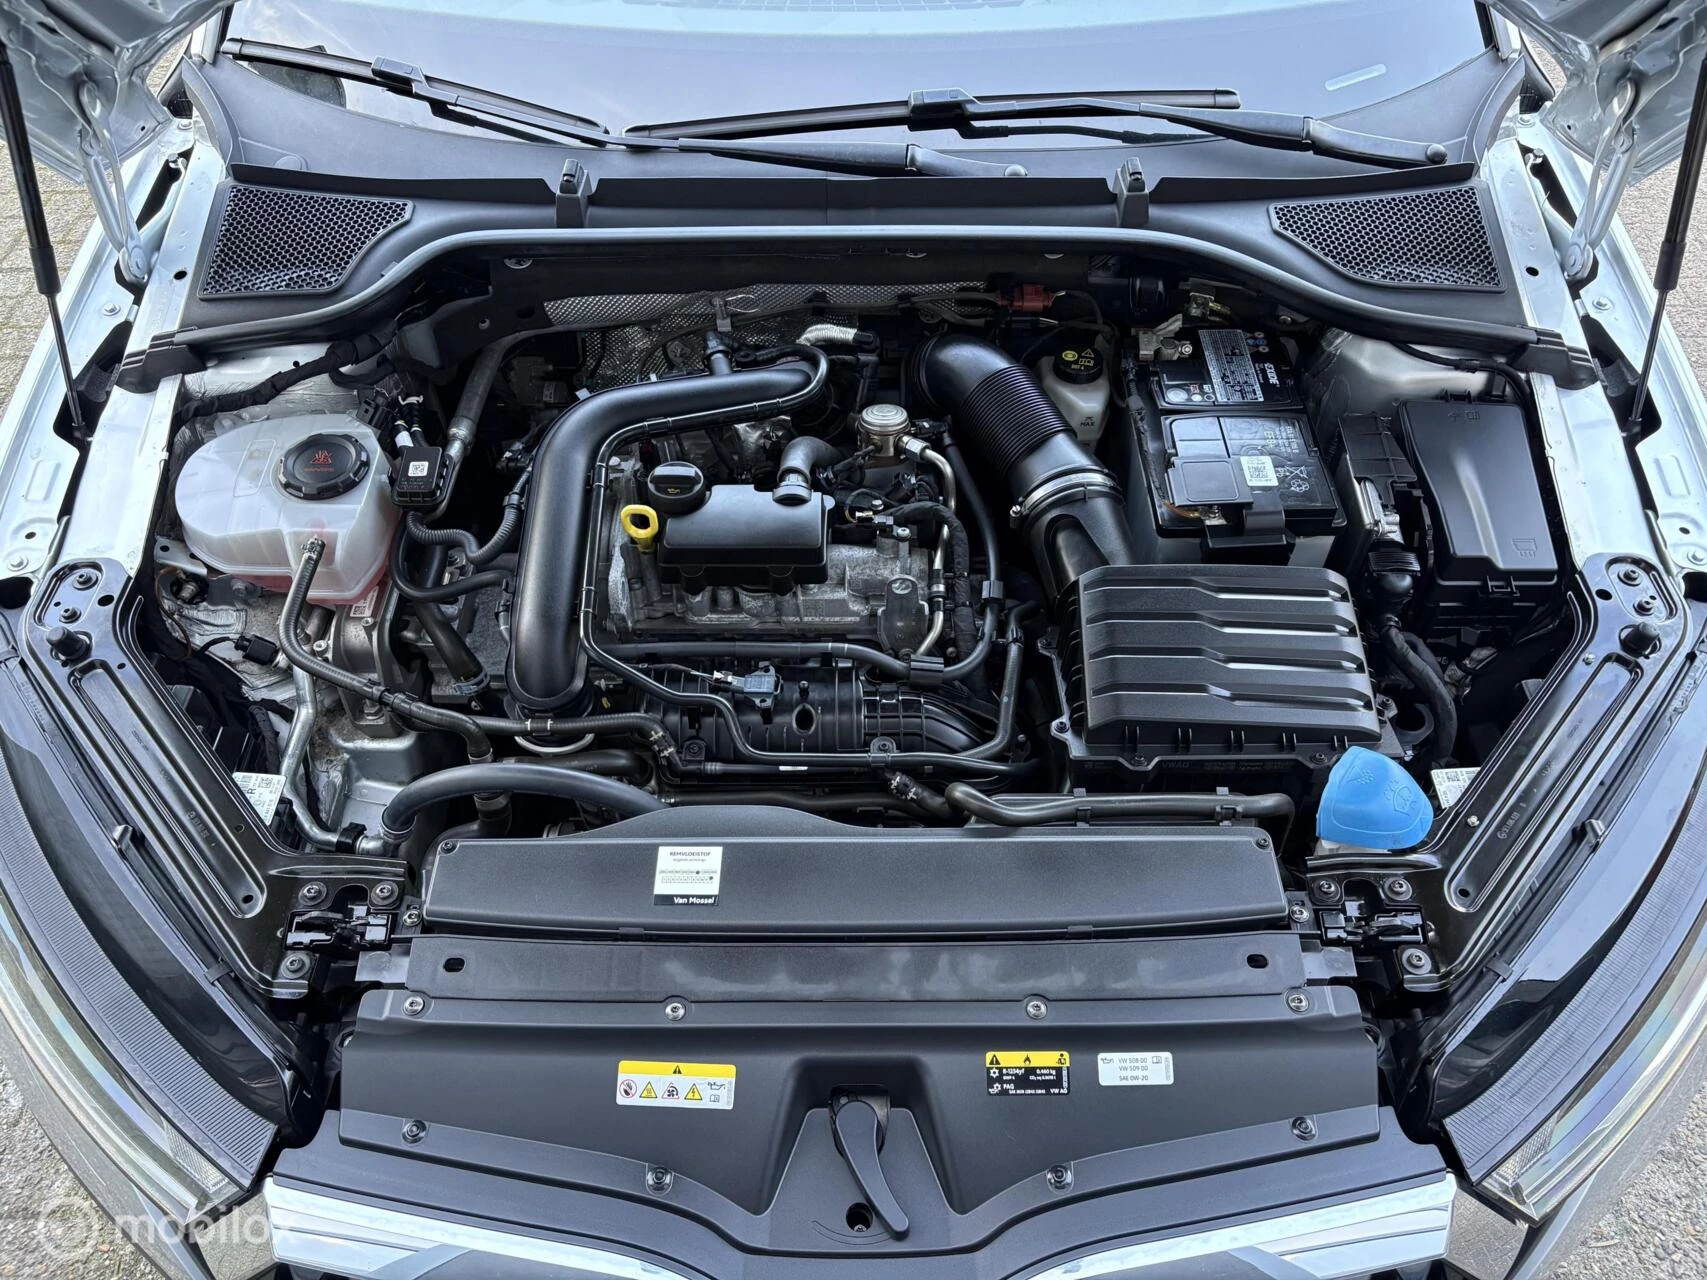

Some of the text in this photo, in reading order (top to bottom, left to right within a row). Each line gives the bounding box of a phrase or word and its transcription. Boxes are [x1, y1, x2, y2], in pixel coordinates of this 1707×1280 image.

[1264, 362, 1280, 385] EXIDE
[673, 896, 715, 904] Van Mossel
